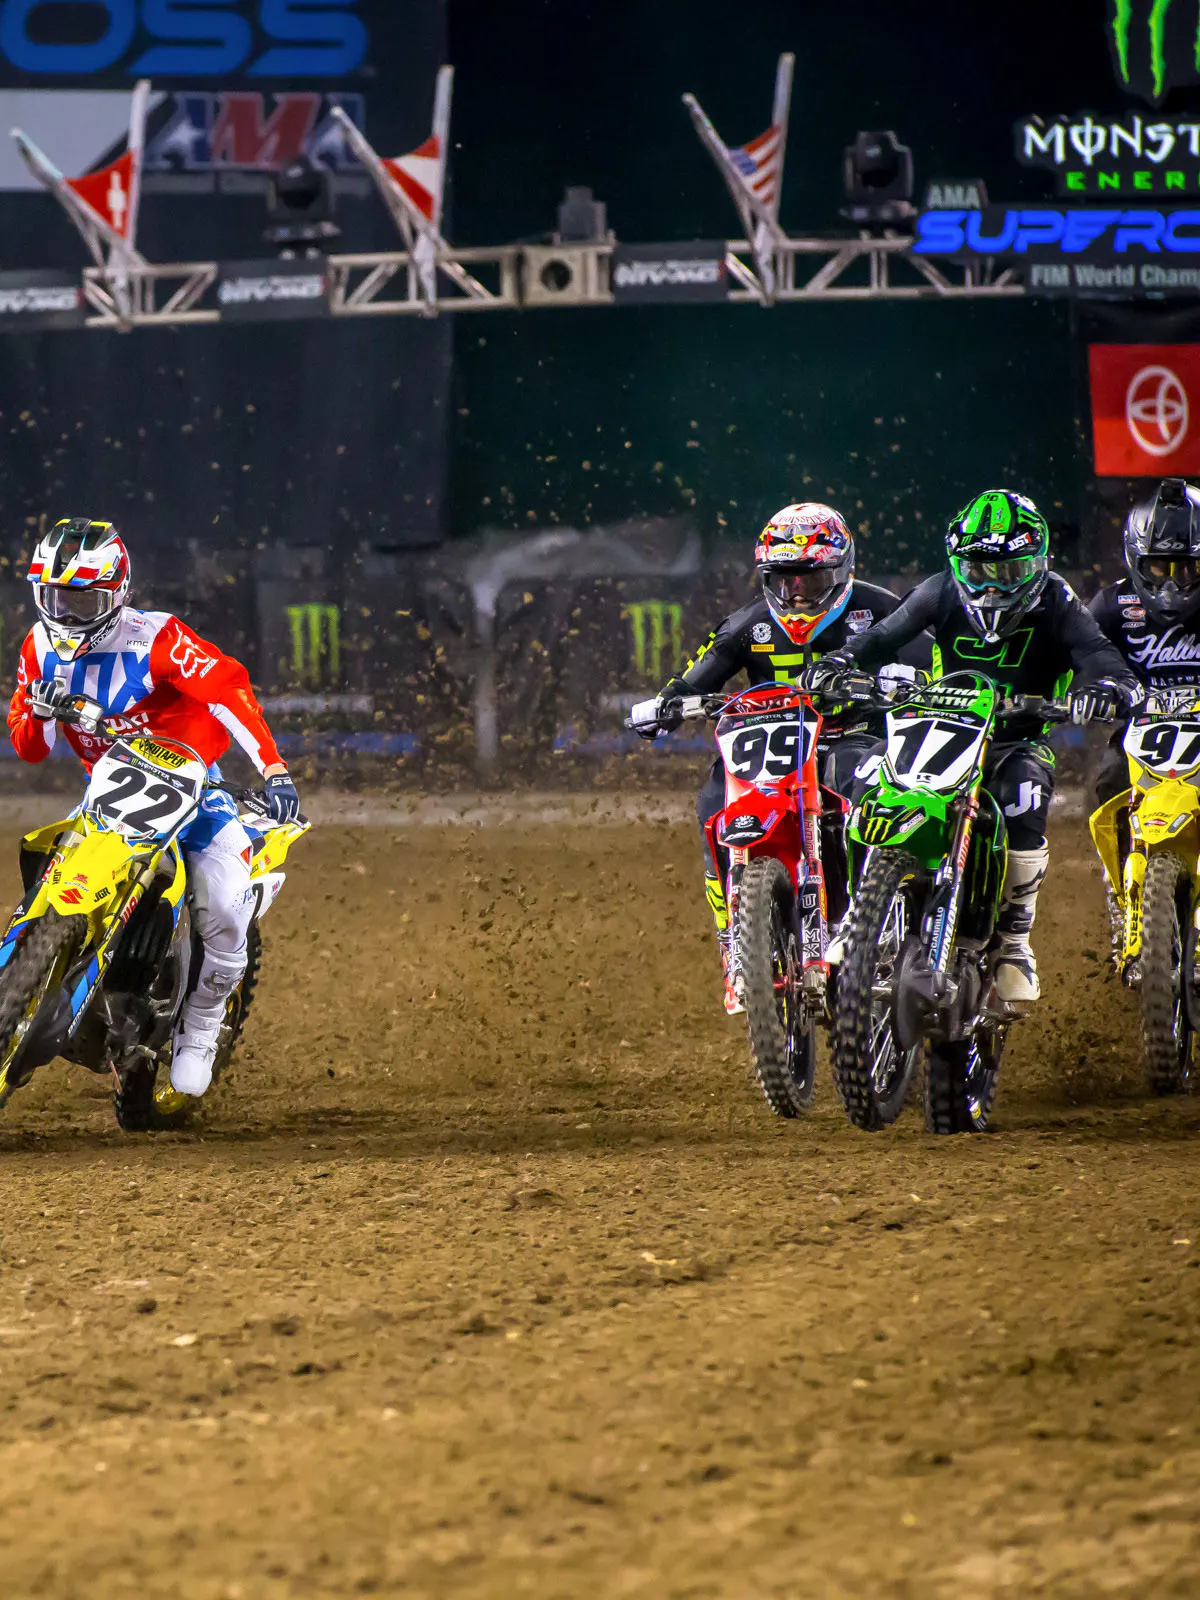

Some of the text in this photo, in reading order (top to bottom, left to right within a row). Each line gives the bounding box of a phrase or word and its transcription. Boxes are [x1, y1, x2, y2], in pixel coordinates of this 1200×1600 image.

[139, 91, 366, 170] AMA
[927, 183, 981, 208] AMA
[1065, 171, 1200, 190] ENER
[1031, 264, 1200, 288] FIM World Cham
[731, 724, 811, 781] 99
[892, 720, 982, 776] 17
[1137, 723, 1200, 767] 97
[136, 759, 171, 780] MONSTER
[92, 766, 183, 839] 22
[93, 886, 111, 903] JGR
[931, 906, 945, 951] CARRILLO
[938, 896, 958, 973] DUNLOP
